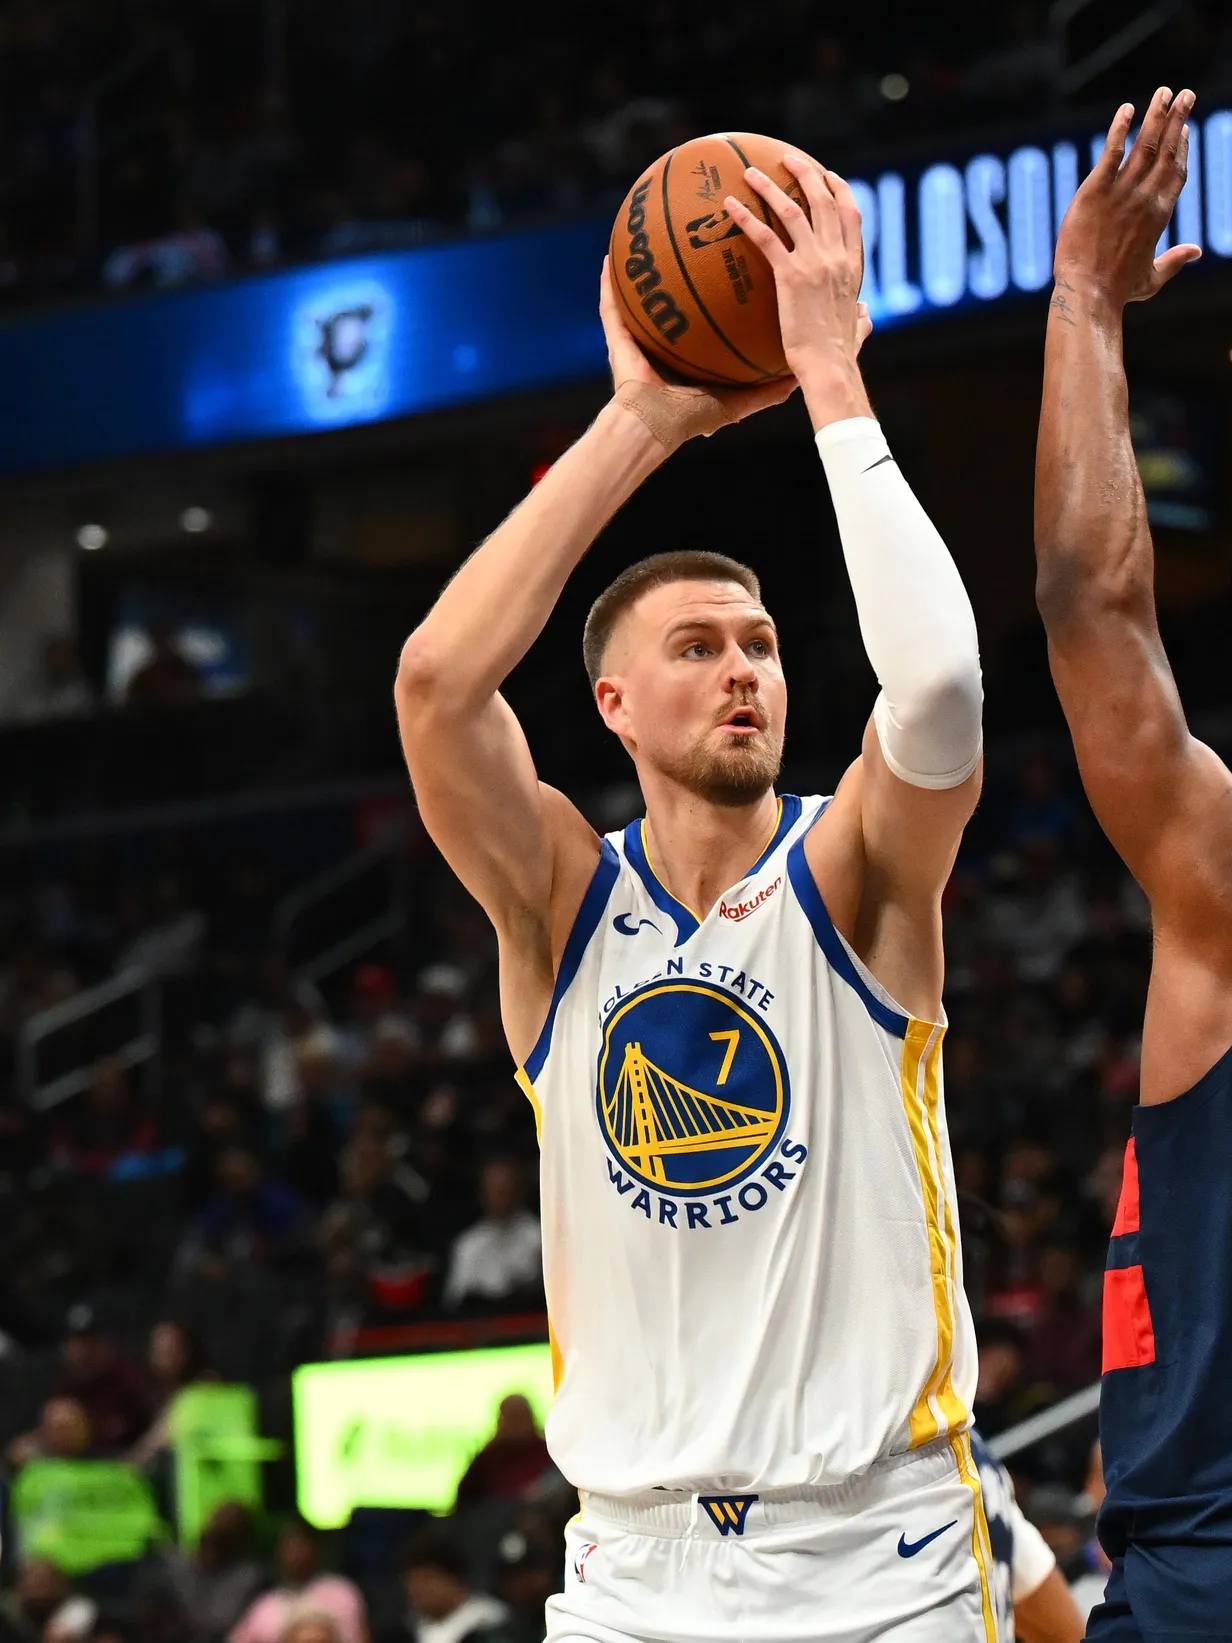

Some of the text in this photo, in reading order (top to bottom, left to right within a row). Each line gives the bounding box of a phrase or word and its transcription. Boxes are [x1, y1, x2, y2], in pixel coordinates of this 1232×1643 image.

[624, 175, 691, 346] Wilson
[719, 876, 782, 920] Rakuten
[698, 962, 776, 1012] STATE
[708, 1029, 742, 1086] 7
[606, 1138, 809, 1230] WARRIORS
